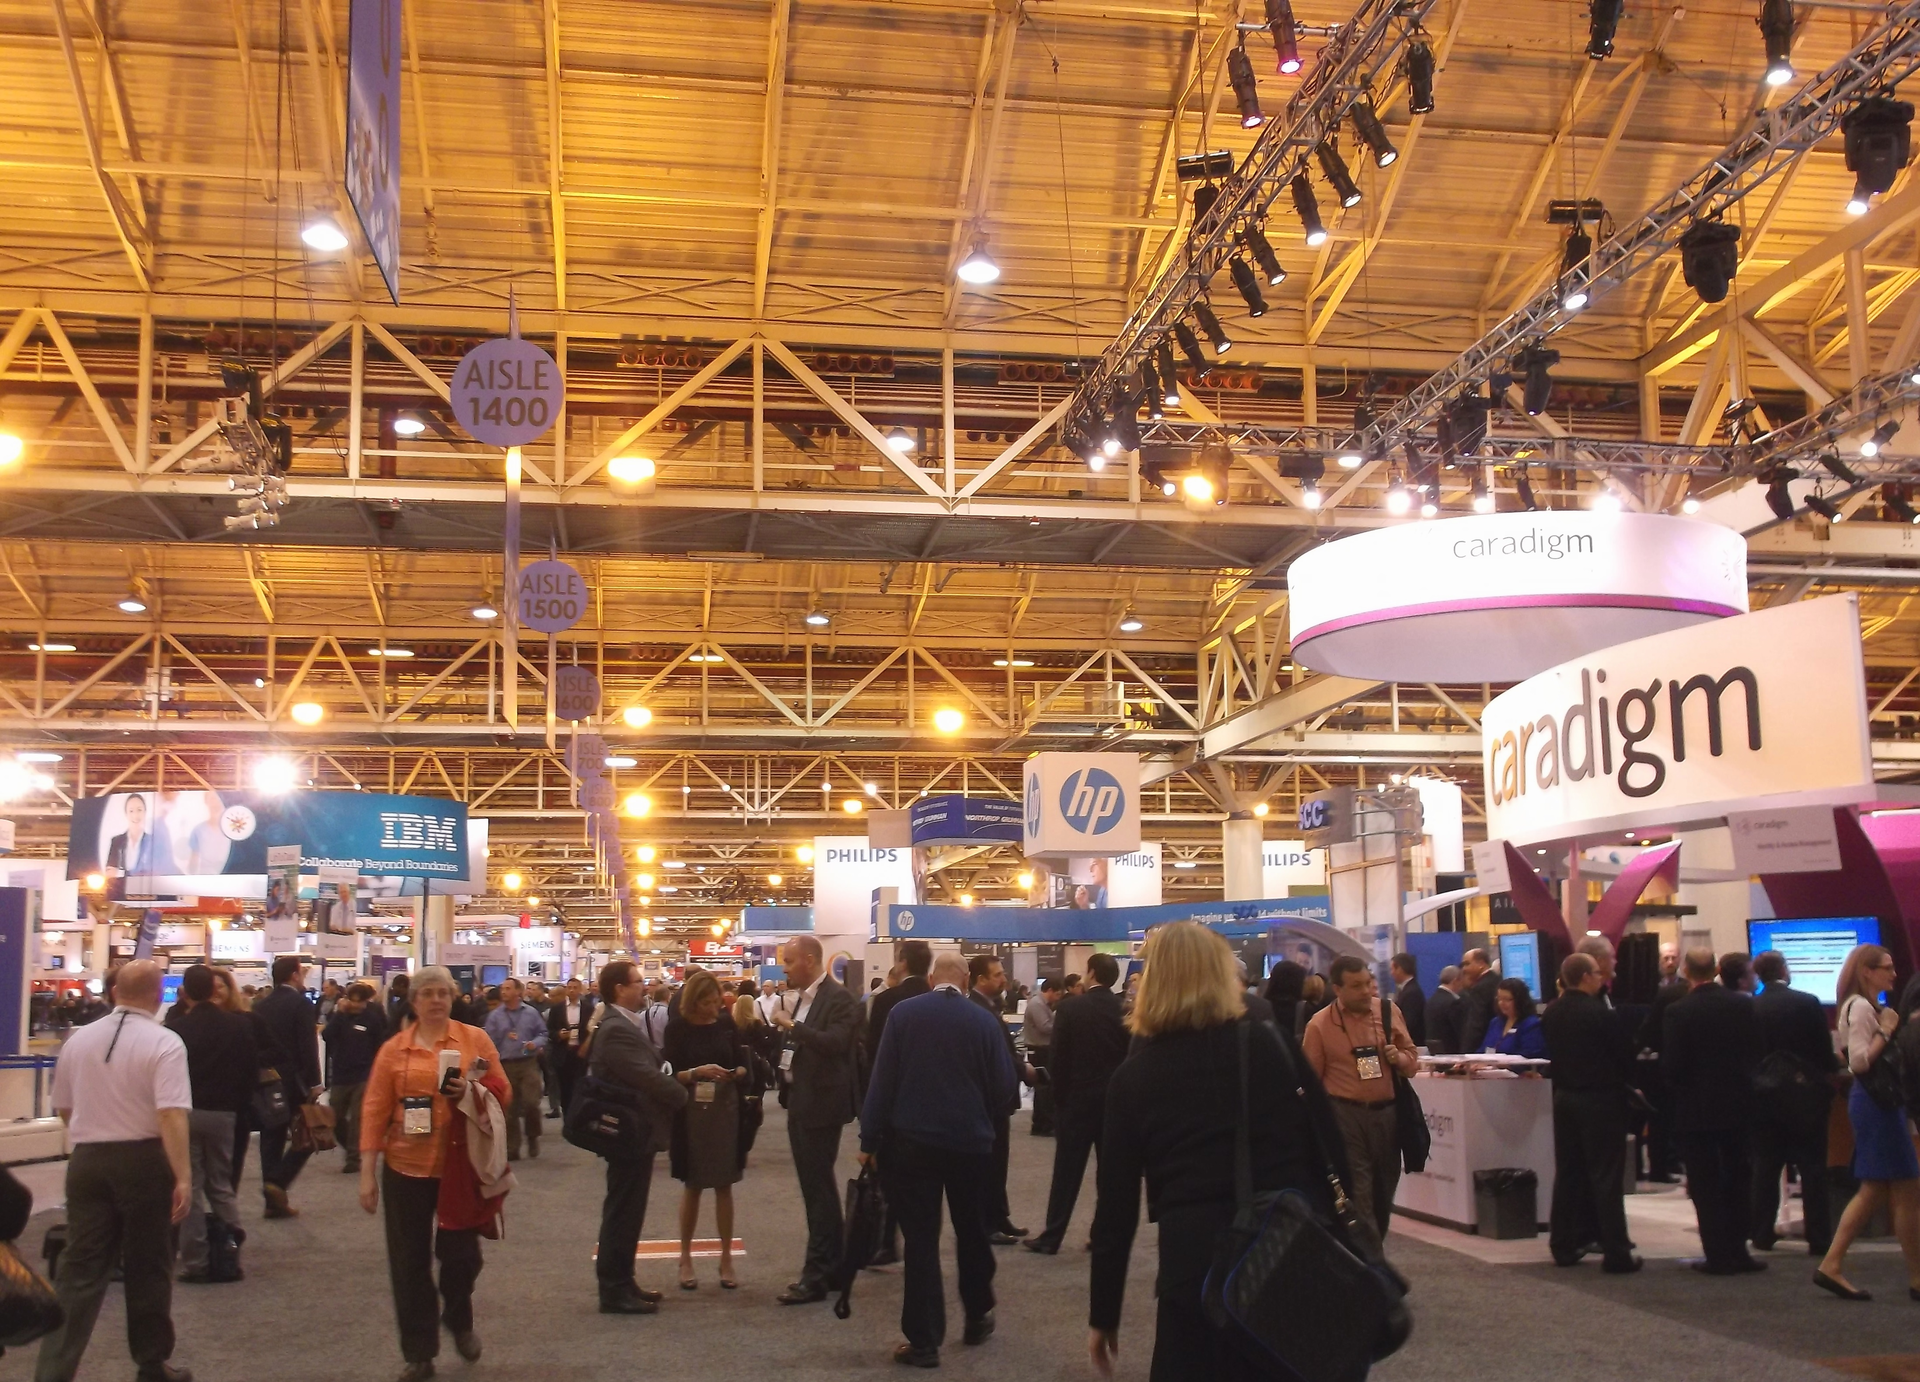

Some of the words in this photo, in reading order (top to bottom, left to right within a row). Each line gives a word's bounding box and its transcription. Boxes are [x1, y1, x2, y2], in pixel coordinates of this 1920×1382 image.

[464, 360, 549, 391] AISLE
[470, 397, 549, 427] 1400
[1453, 527, 1594, 560] caradigm
[520, 574, 578, 595] AISLE
[523, 599, 577, 619] 1500
[1491, 665, 1761, 807] caradigm
[577, 742, 604, 755] ISLE
[578, 758, 604, 770] 700
[1064, 767, 1121, 835] hp
[380, 813, 457, 852] IBM
[1754, 819, 1788, 830] caradigm
[299, 857, 364, 869] Collaborate
[364, 858, 405, 871] Beyond
[406, 860, 459, 872] Boundaries
[827, 848, 898, 863] PHILIPS
[1115, 853, 1155, 868] PHILIPS
[898, 911, 914, 930] hp
[1190, 912, 1223, 925] Imagine
[1302, 906, 1328, 918] limits
[520, 940, 555, 950] SIEMENS
[706, 942, 737, 955] Epic
[1424, 1108, 1454, 1137] adigm
